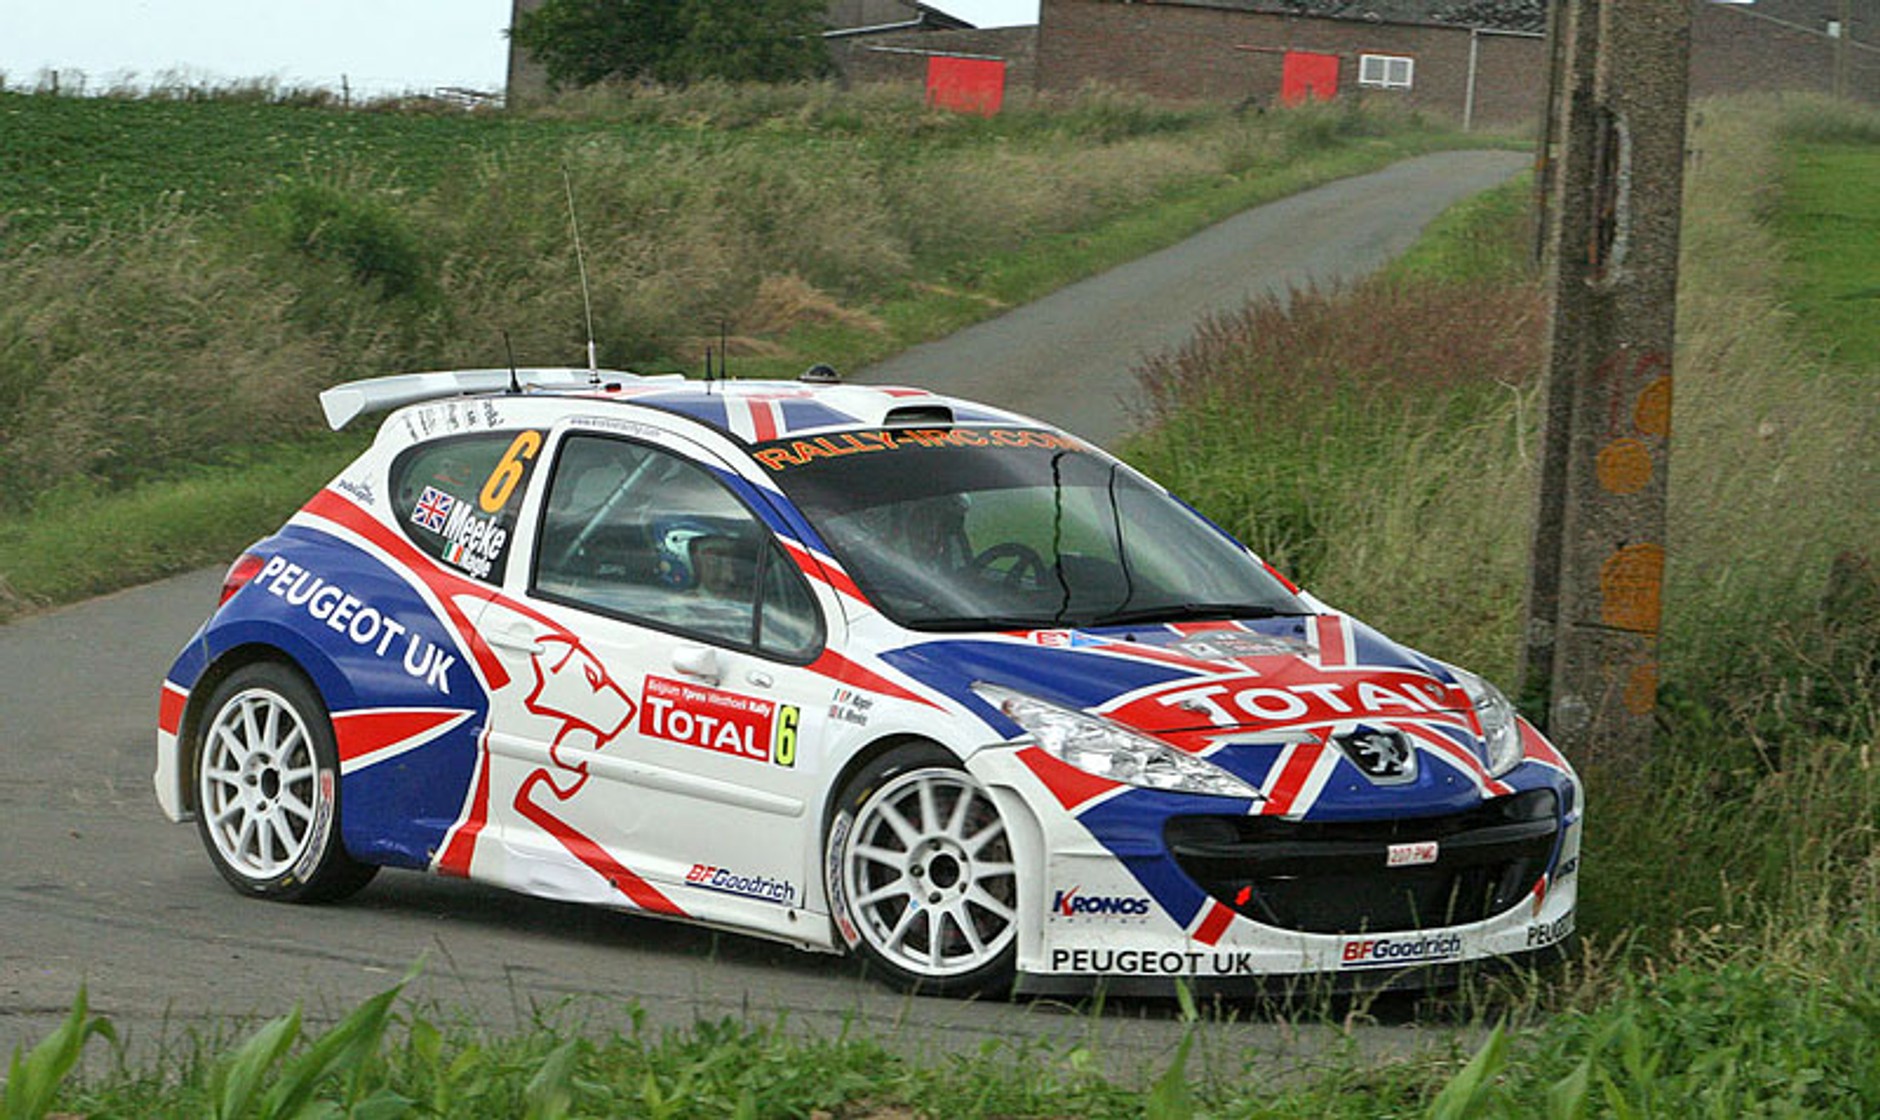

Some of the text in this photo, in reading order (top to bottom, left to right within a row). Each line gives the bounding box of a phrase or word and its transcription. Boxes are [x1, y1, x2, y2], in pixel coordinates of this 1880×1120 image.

[480, 429, 542, 514] 6
[442, 500, 506, 560] Meeke
[254, 556, 456, 695] PEUGEOT UK
[645, 694, 767, 758] TOTAL
[1156, 681, 1448, 729] TOTAL
[776, 704, 799, 766] 6
[686, 864, 796, 899] BFGoodrich
[1052, 885, 1150, 917] KRONOS
[1052, 950, 1253, 974] PEUGEOT UK
[1343, 933, 1462, 961] BFGoodrich
